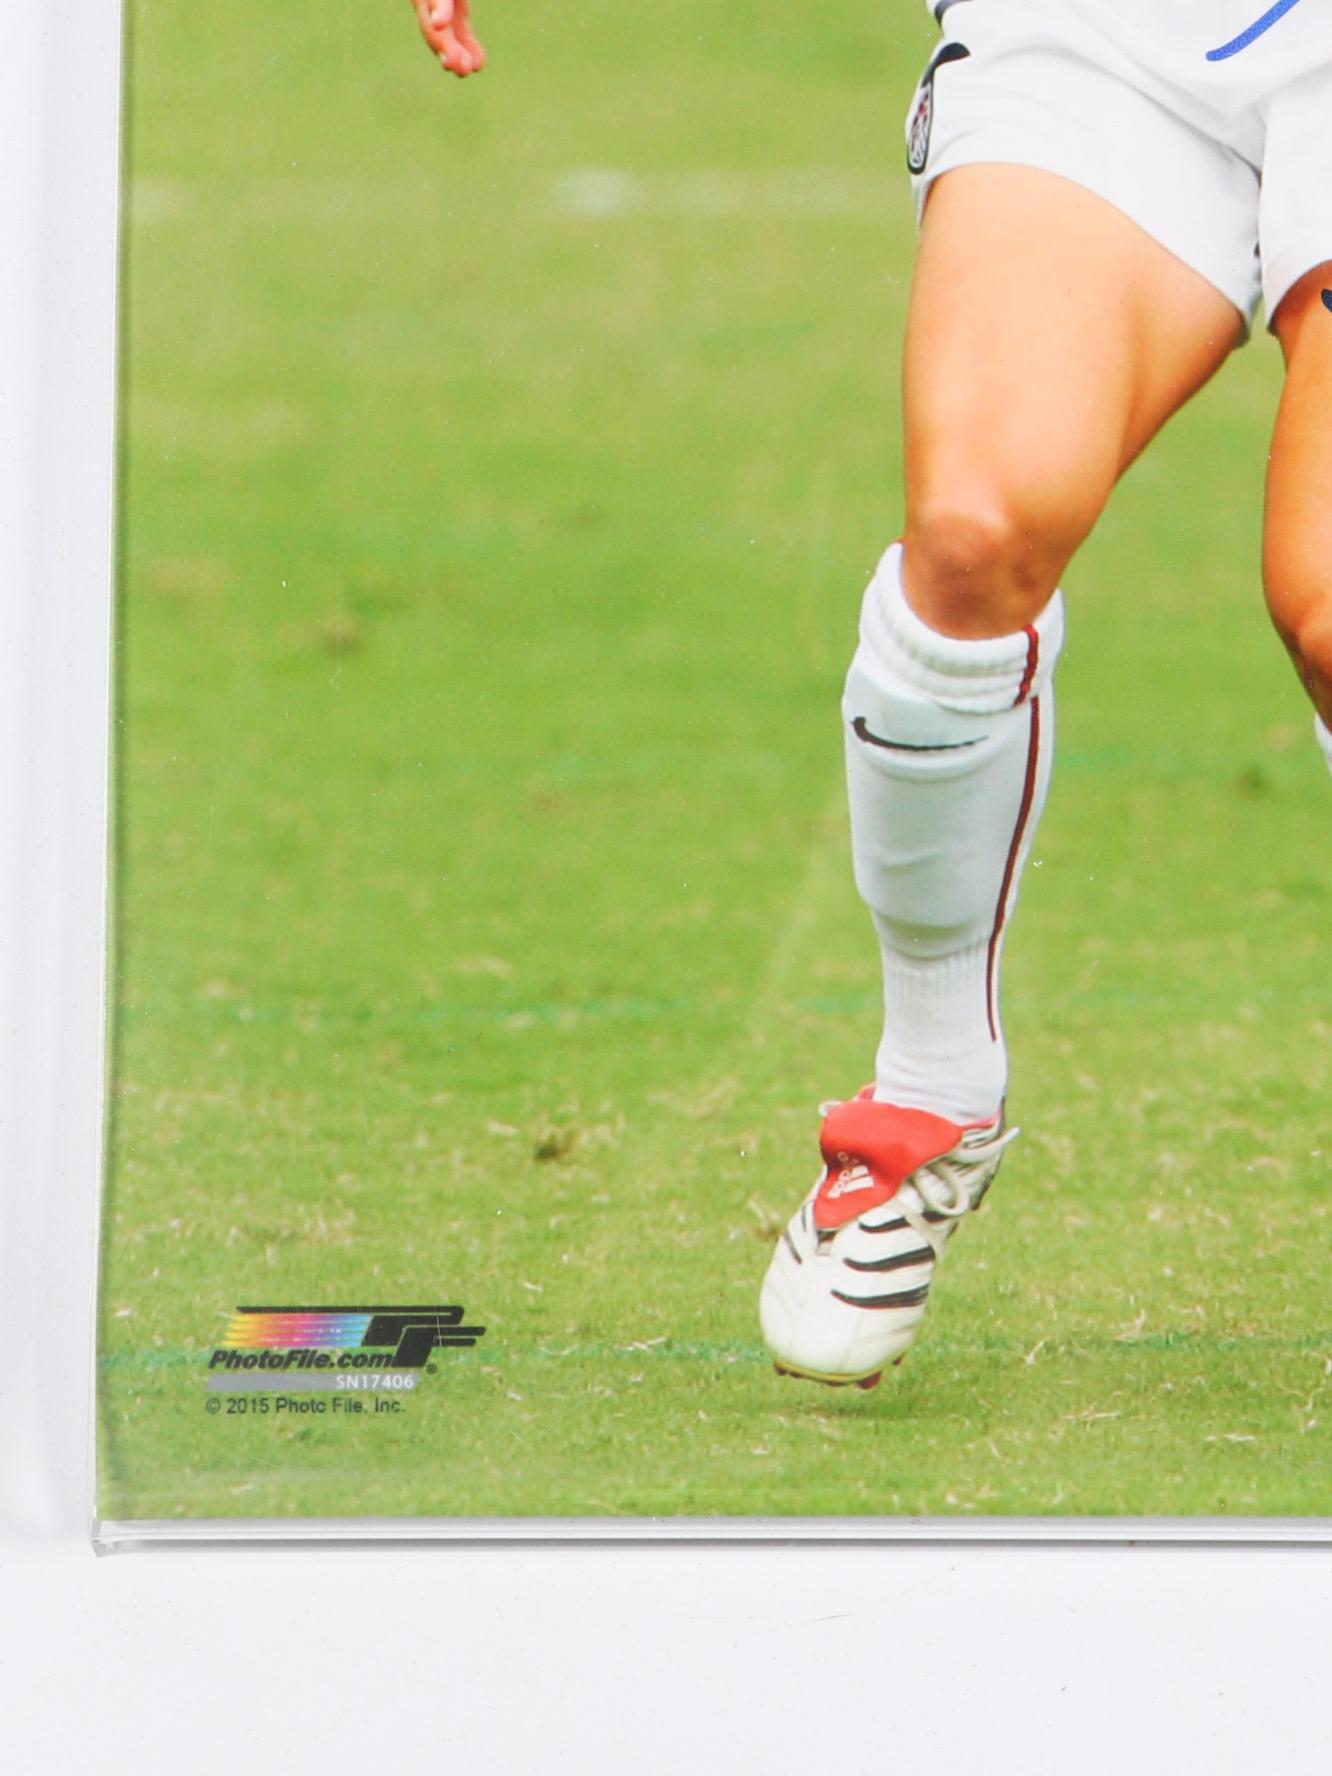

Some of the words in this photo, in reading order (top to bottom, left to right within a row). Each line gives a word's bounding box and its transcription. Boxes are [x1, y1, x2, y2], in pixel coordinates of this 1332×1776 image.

[207, 1348, 400, 1370] PhotoFile.com
[335, 1374, 415, 1390] SN17406
[226, 1397, 270, 1414] 2015
[275, 1397, 327, 1414] Photo
[374, 1397, 406, 1414] Inc.
